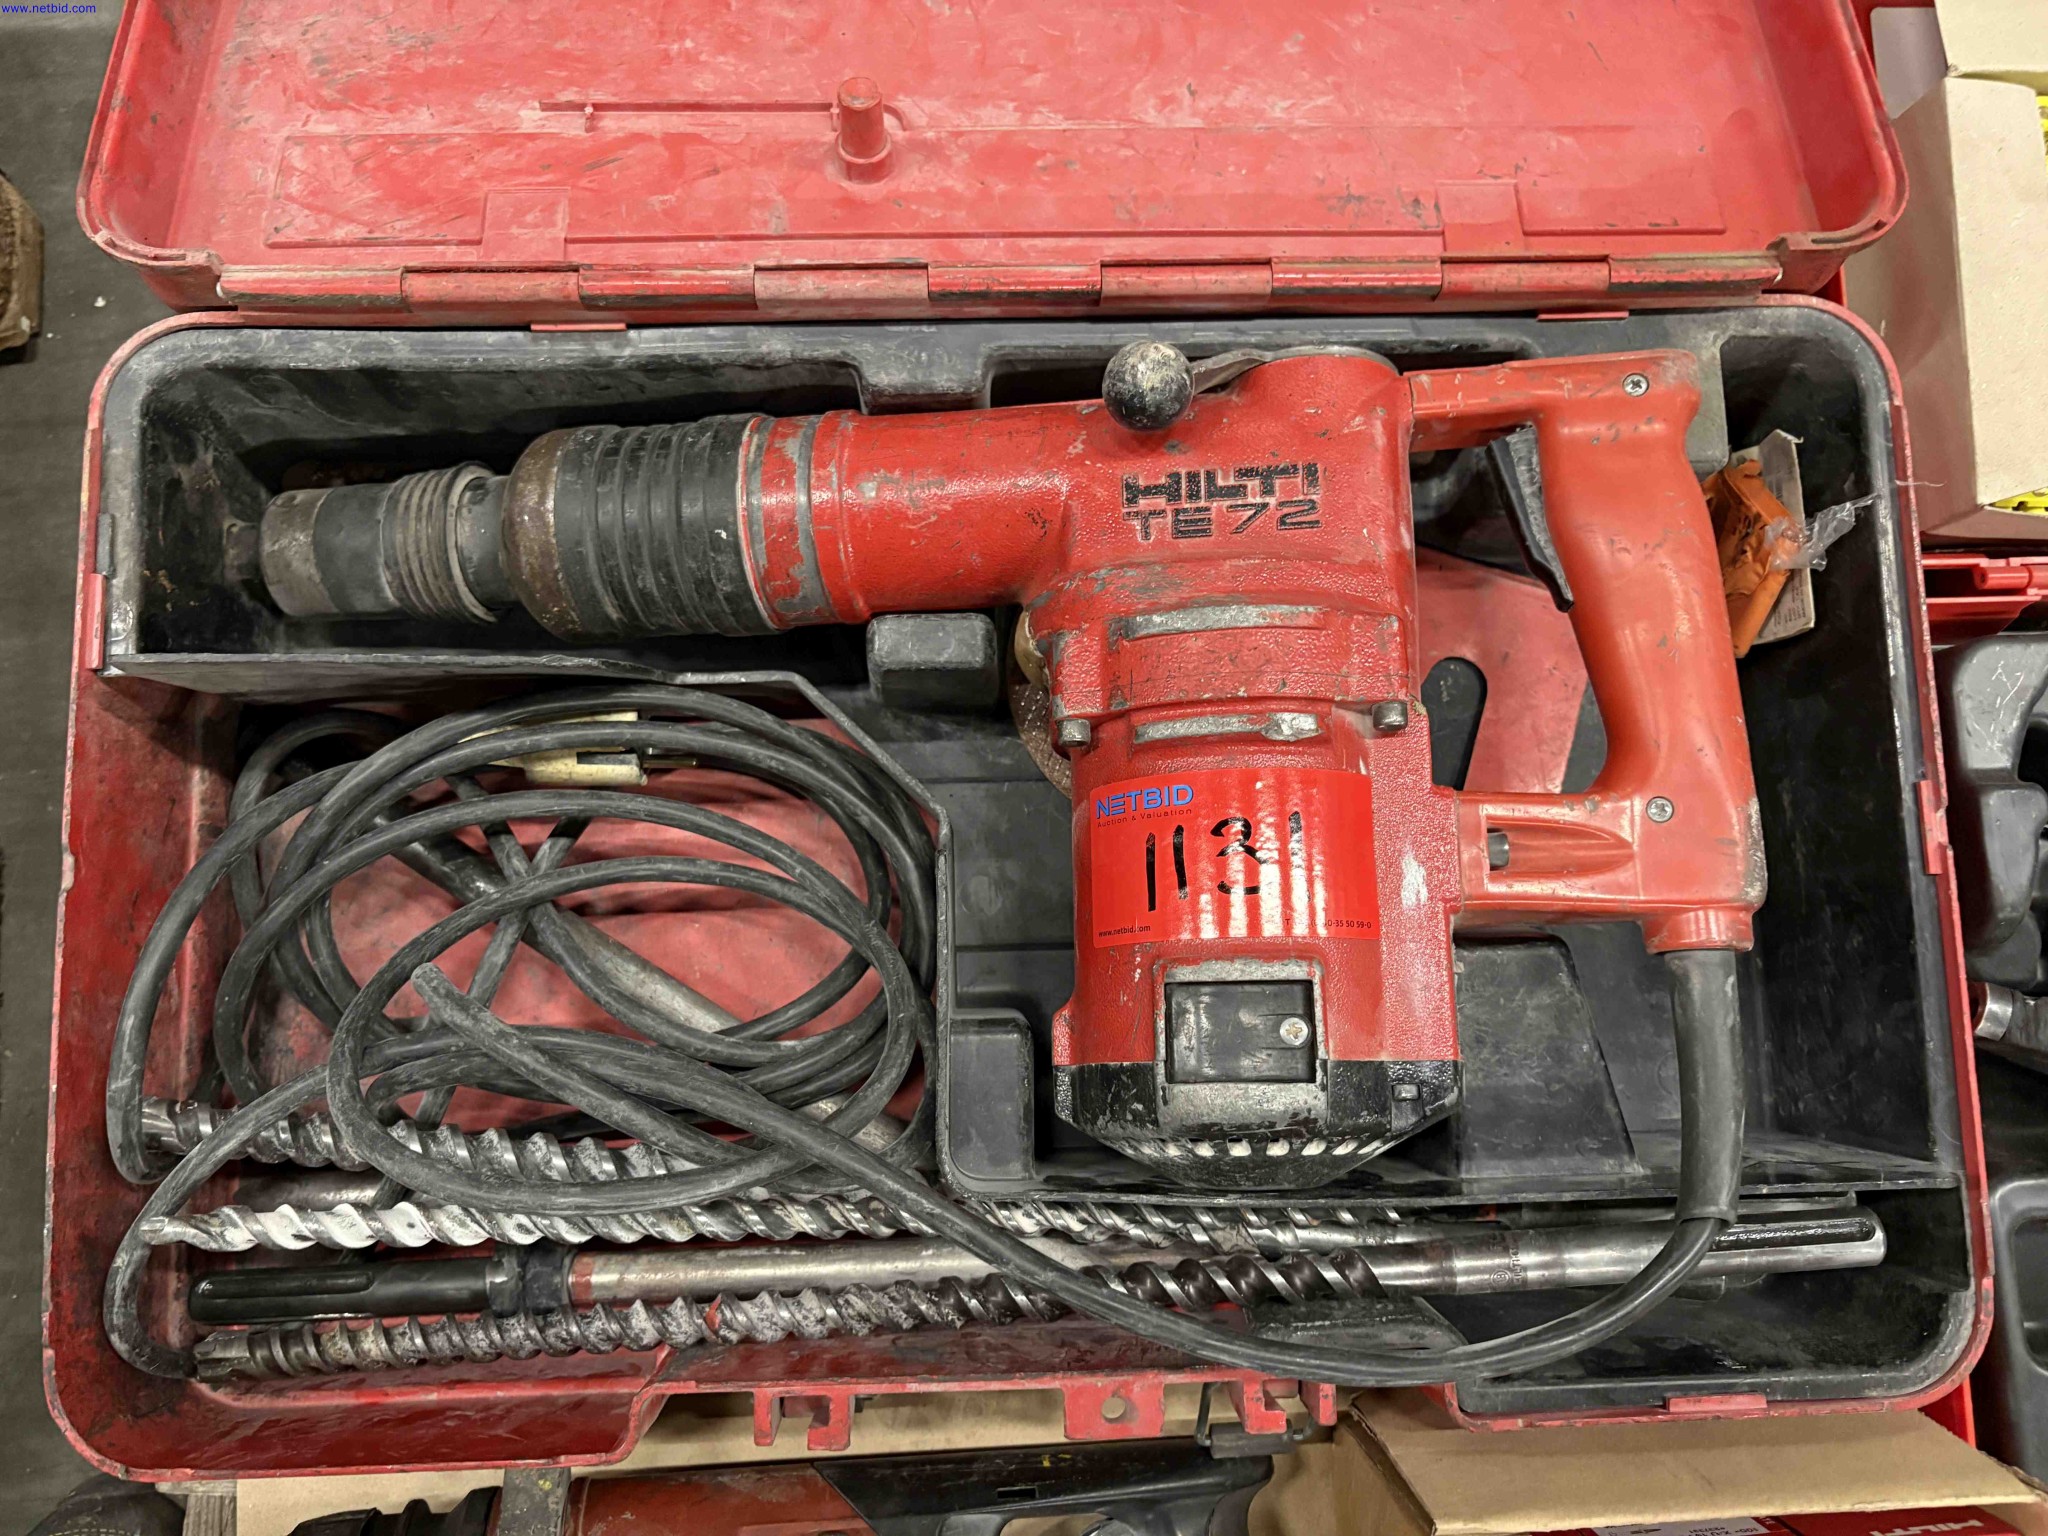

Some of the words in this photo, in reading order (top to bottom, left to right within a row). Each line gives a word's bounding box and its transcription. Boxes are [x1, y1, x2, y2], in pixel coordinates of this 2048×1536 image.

[1122, 463, 1320, 508] HILTI
[1123, 506, 1213, 541] TE
[1226, 499, 1323, 535] 72
[1096, 784, 1194, 820] NETBID
[1097, 817, 1128, 828] Auction
[1140, 808, 1192, 820] Valuation
[1098, 925, 1151, 938] www.netbid.com
[1345, 920, 1355, 928] 50
